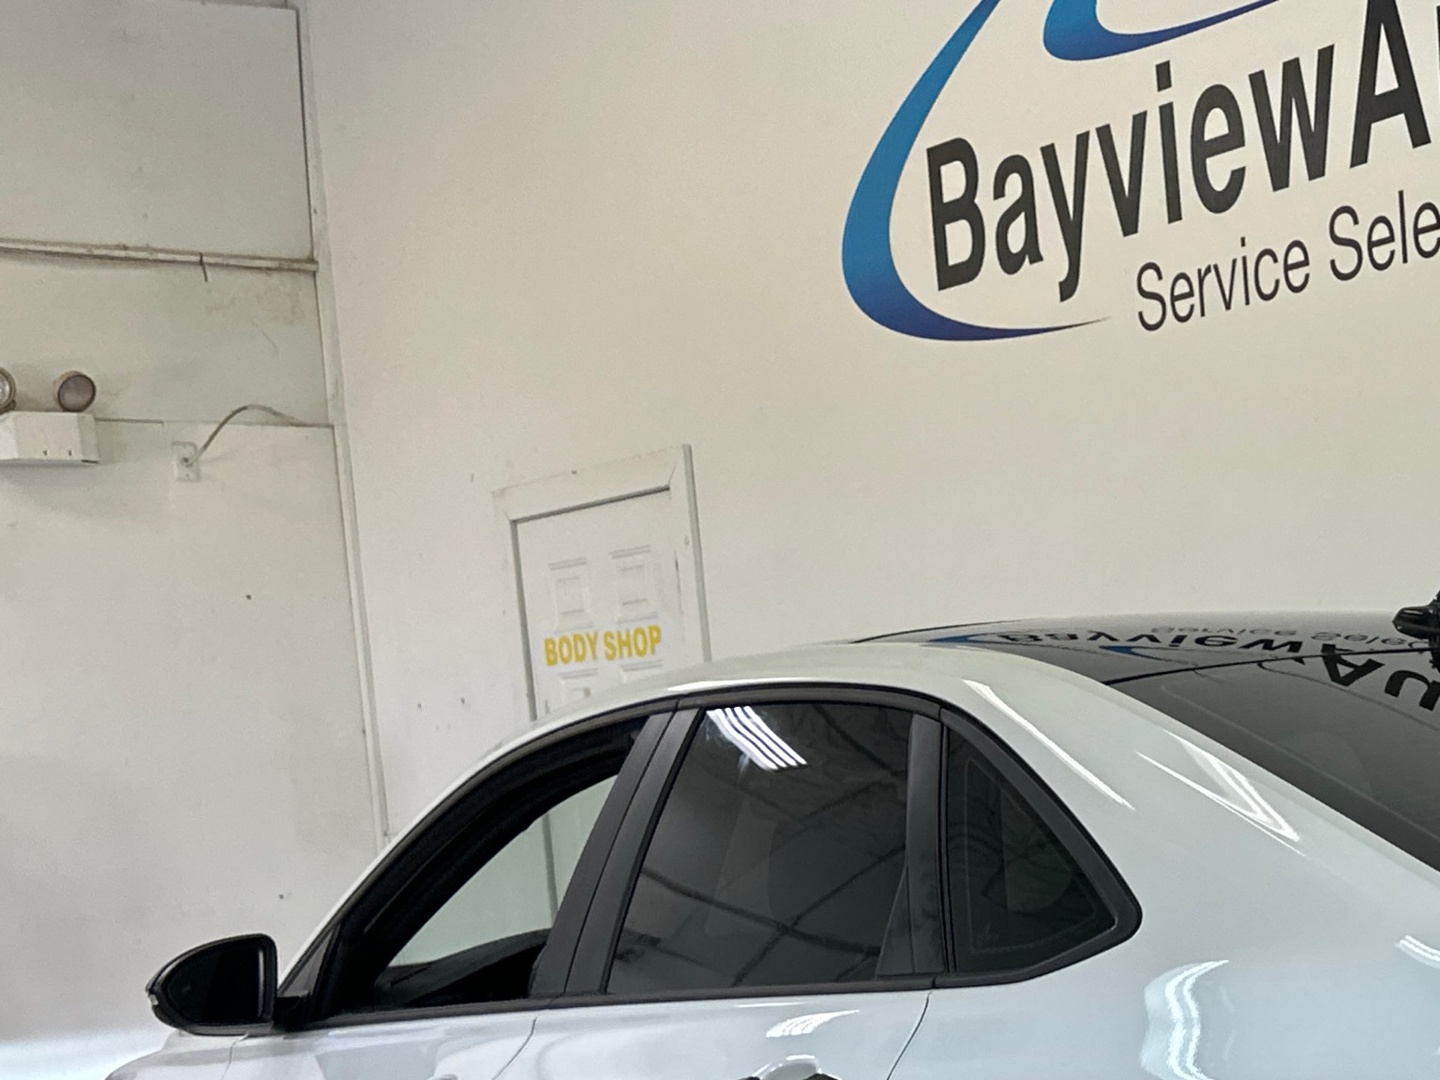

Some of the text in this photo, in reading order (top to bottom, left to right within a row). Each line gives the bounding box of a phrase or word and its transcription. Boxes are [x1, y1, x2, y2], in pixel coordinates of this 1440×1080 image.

[1136, 236, 1311, 332] Service
[544, 624, 662, 667] BODY SHOP
